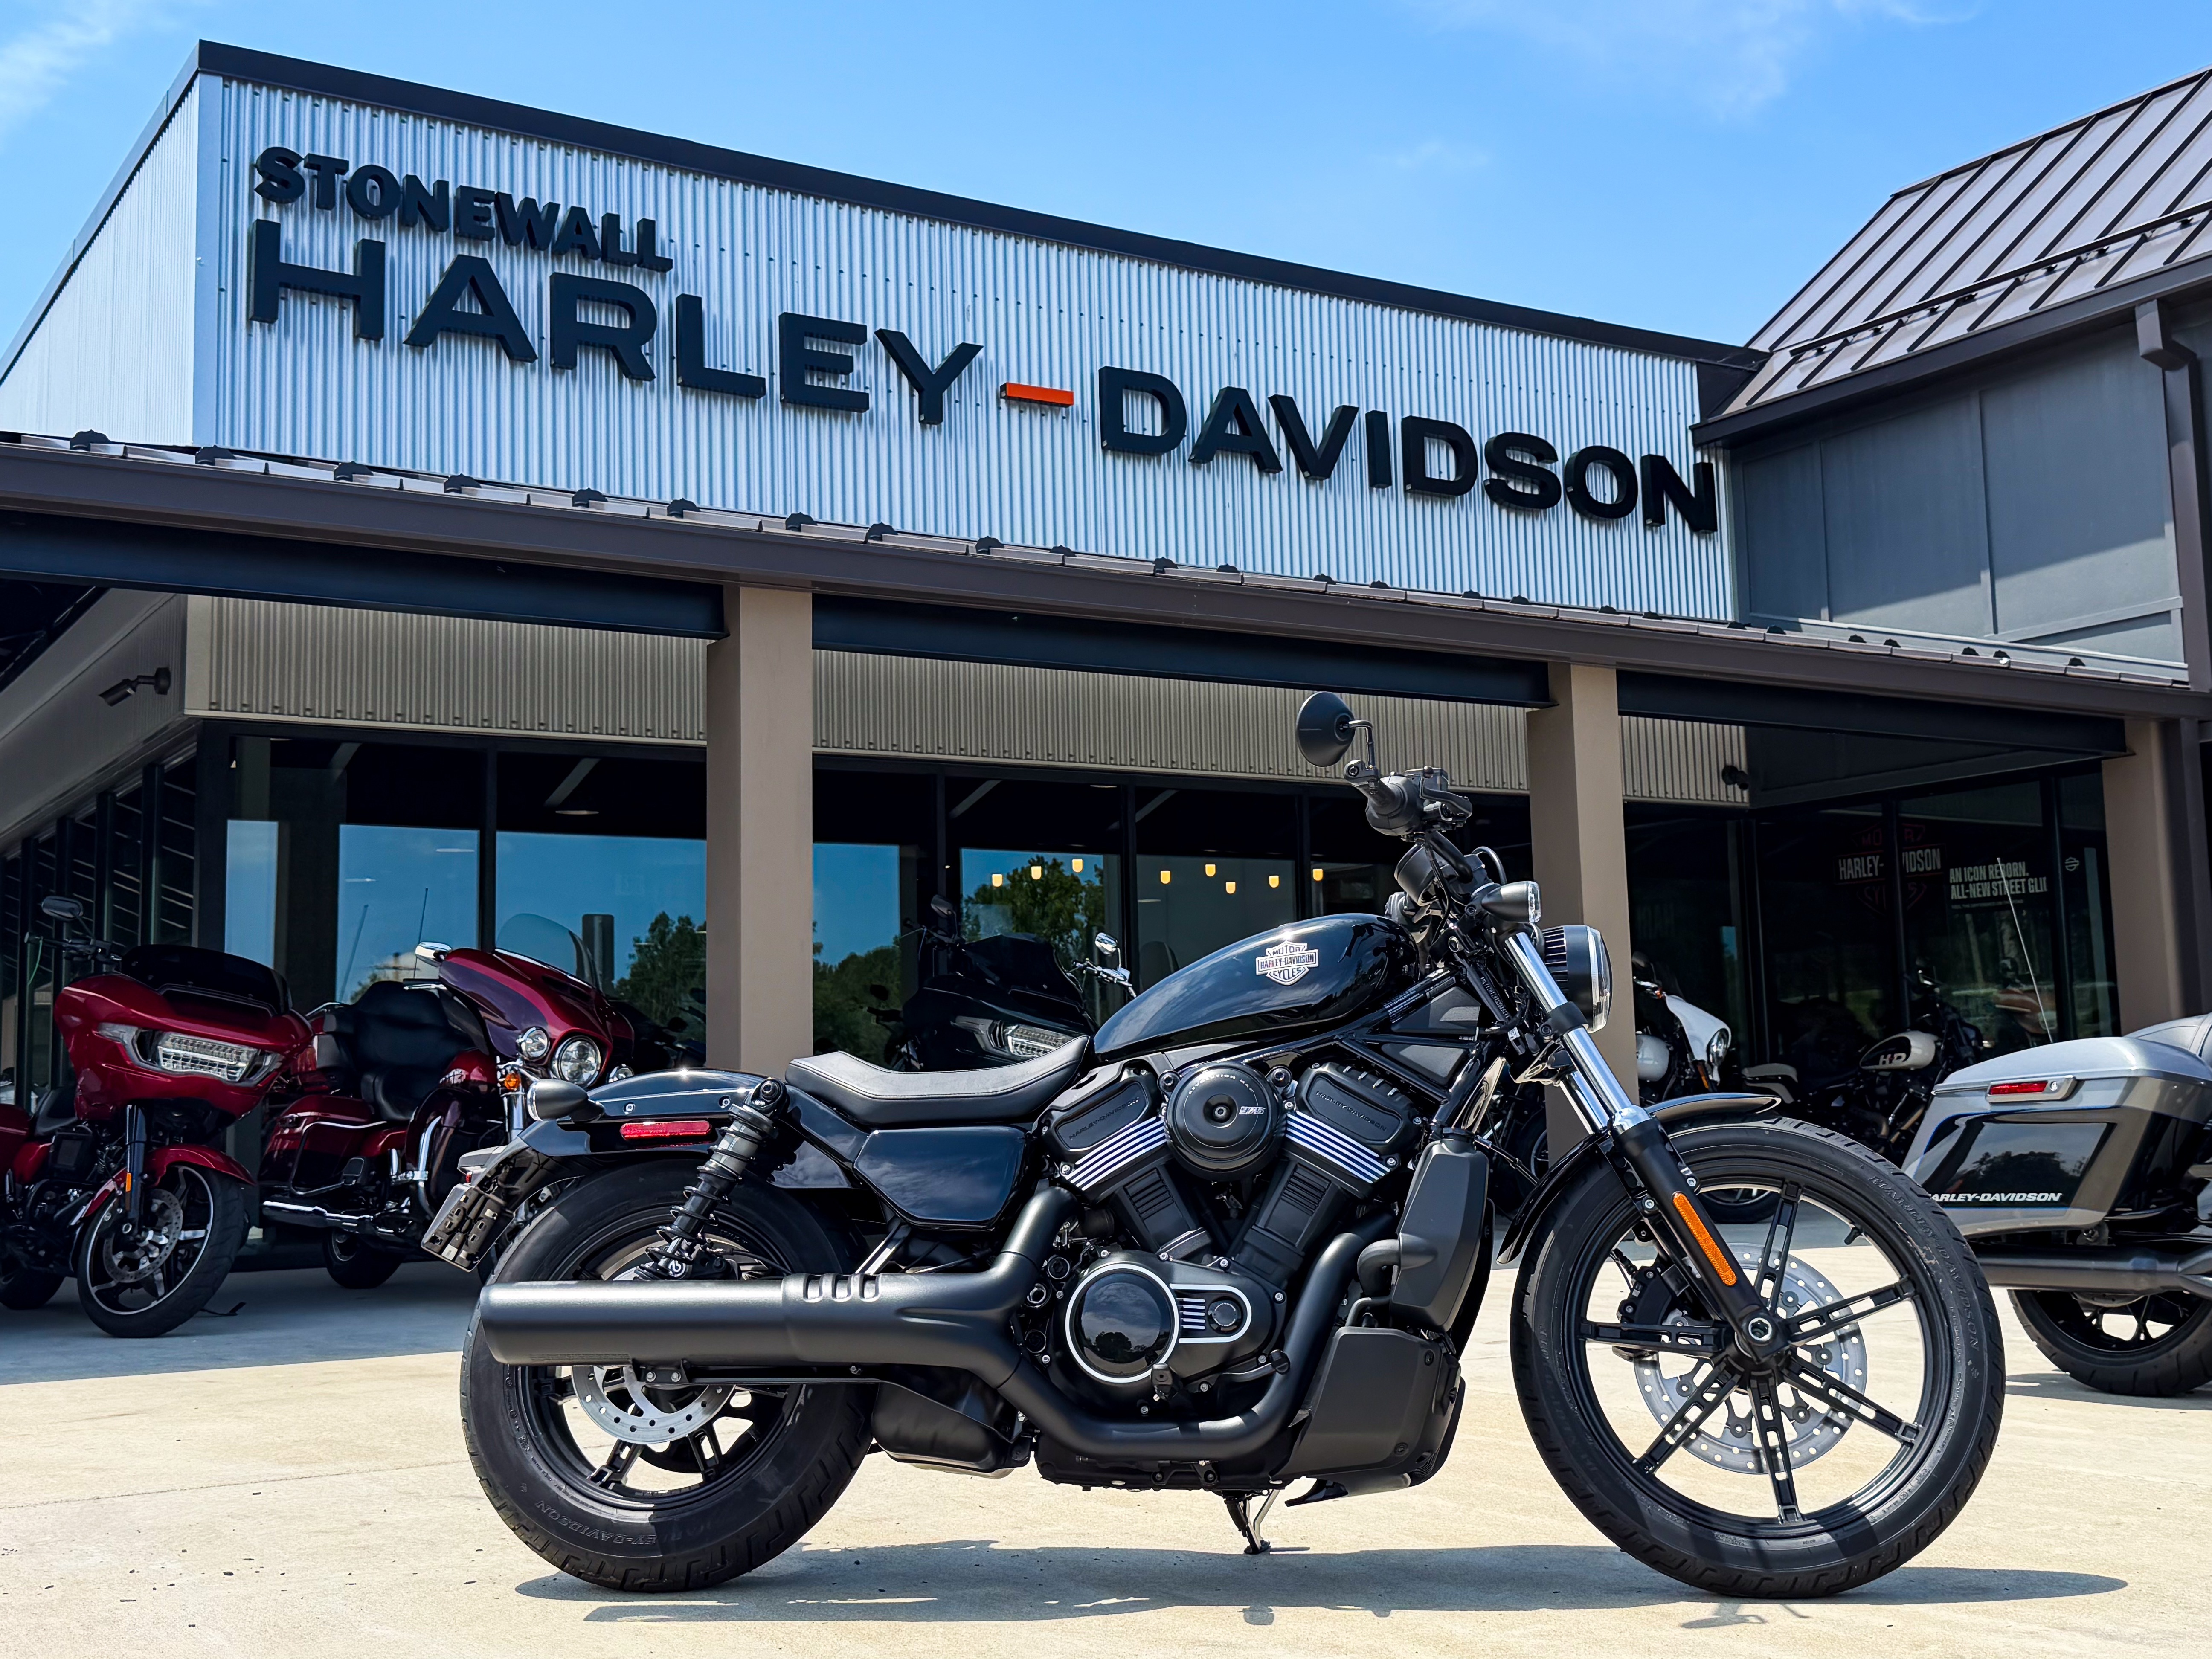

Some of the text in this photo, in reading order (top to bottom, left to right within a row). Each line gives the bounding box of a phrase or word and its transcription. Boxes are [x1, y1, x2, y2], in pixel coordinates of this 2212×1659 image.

[255, 146, 673, 273] STONEWALL
[1949, 867, 1963, 883] AN
[1964, 865, 1987, 882] ICON
[1950, 882, 1991, 899] ALL-NEW
[1272, 945, 1300, 956] MOTOR
[1260, 954, 1314, 969] HARLEY-DAVIDSON
[1929, 1193, 2062, 1202] ARLEY-DAVIDSON
